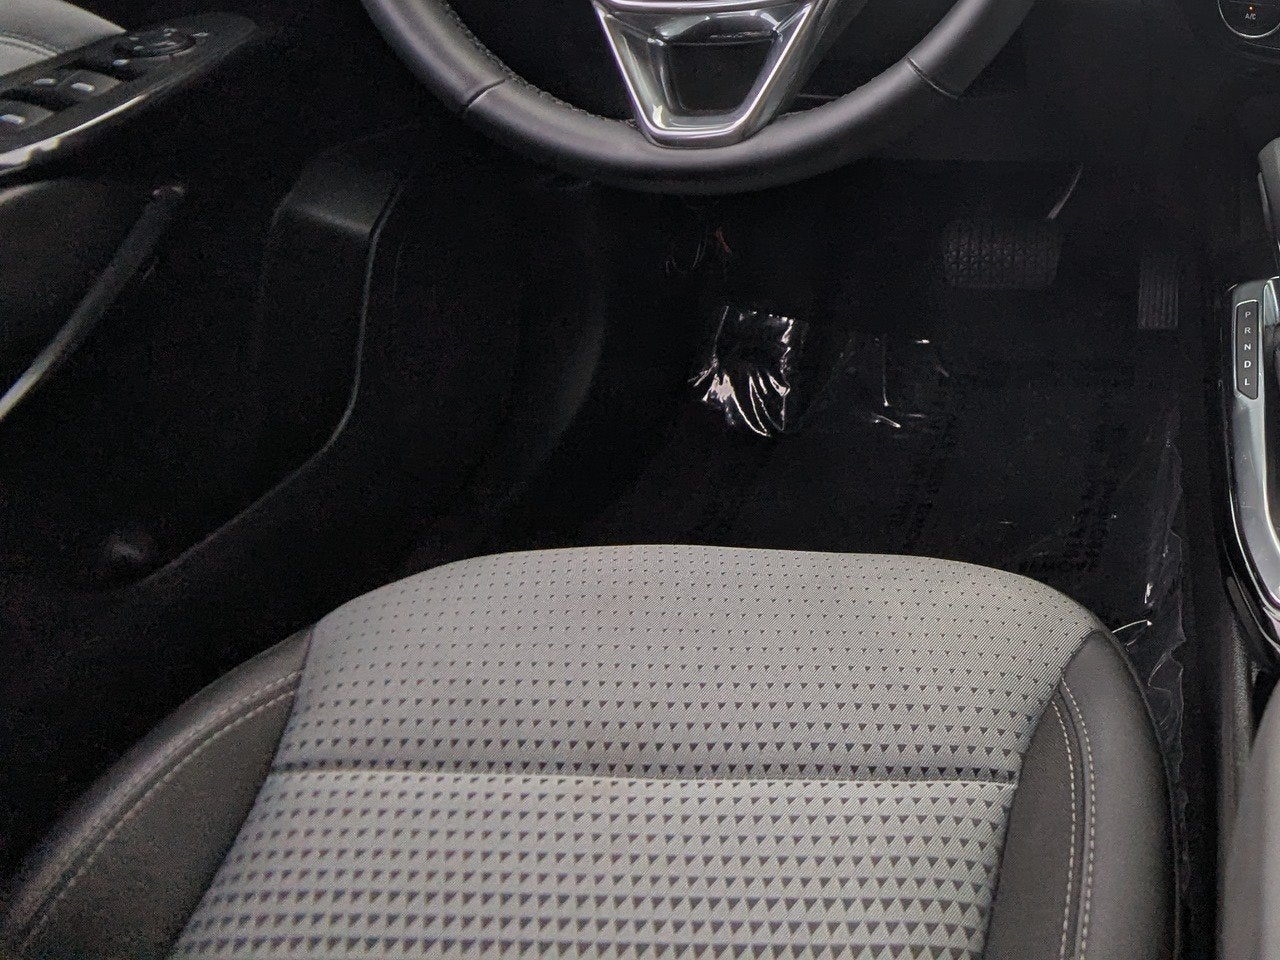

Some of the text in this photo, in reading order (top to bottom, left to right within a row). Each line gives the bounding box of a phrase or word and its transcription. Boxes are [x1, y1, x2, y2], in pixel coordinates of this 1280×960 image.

[1244, 13, 1257, 21] A/C
[1244, 343, 1252, 351] N
[1244, 360, 1252, 369] D
[1244, 378, 1250, 386] L
